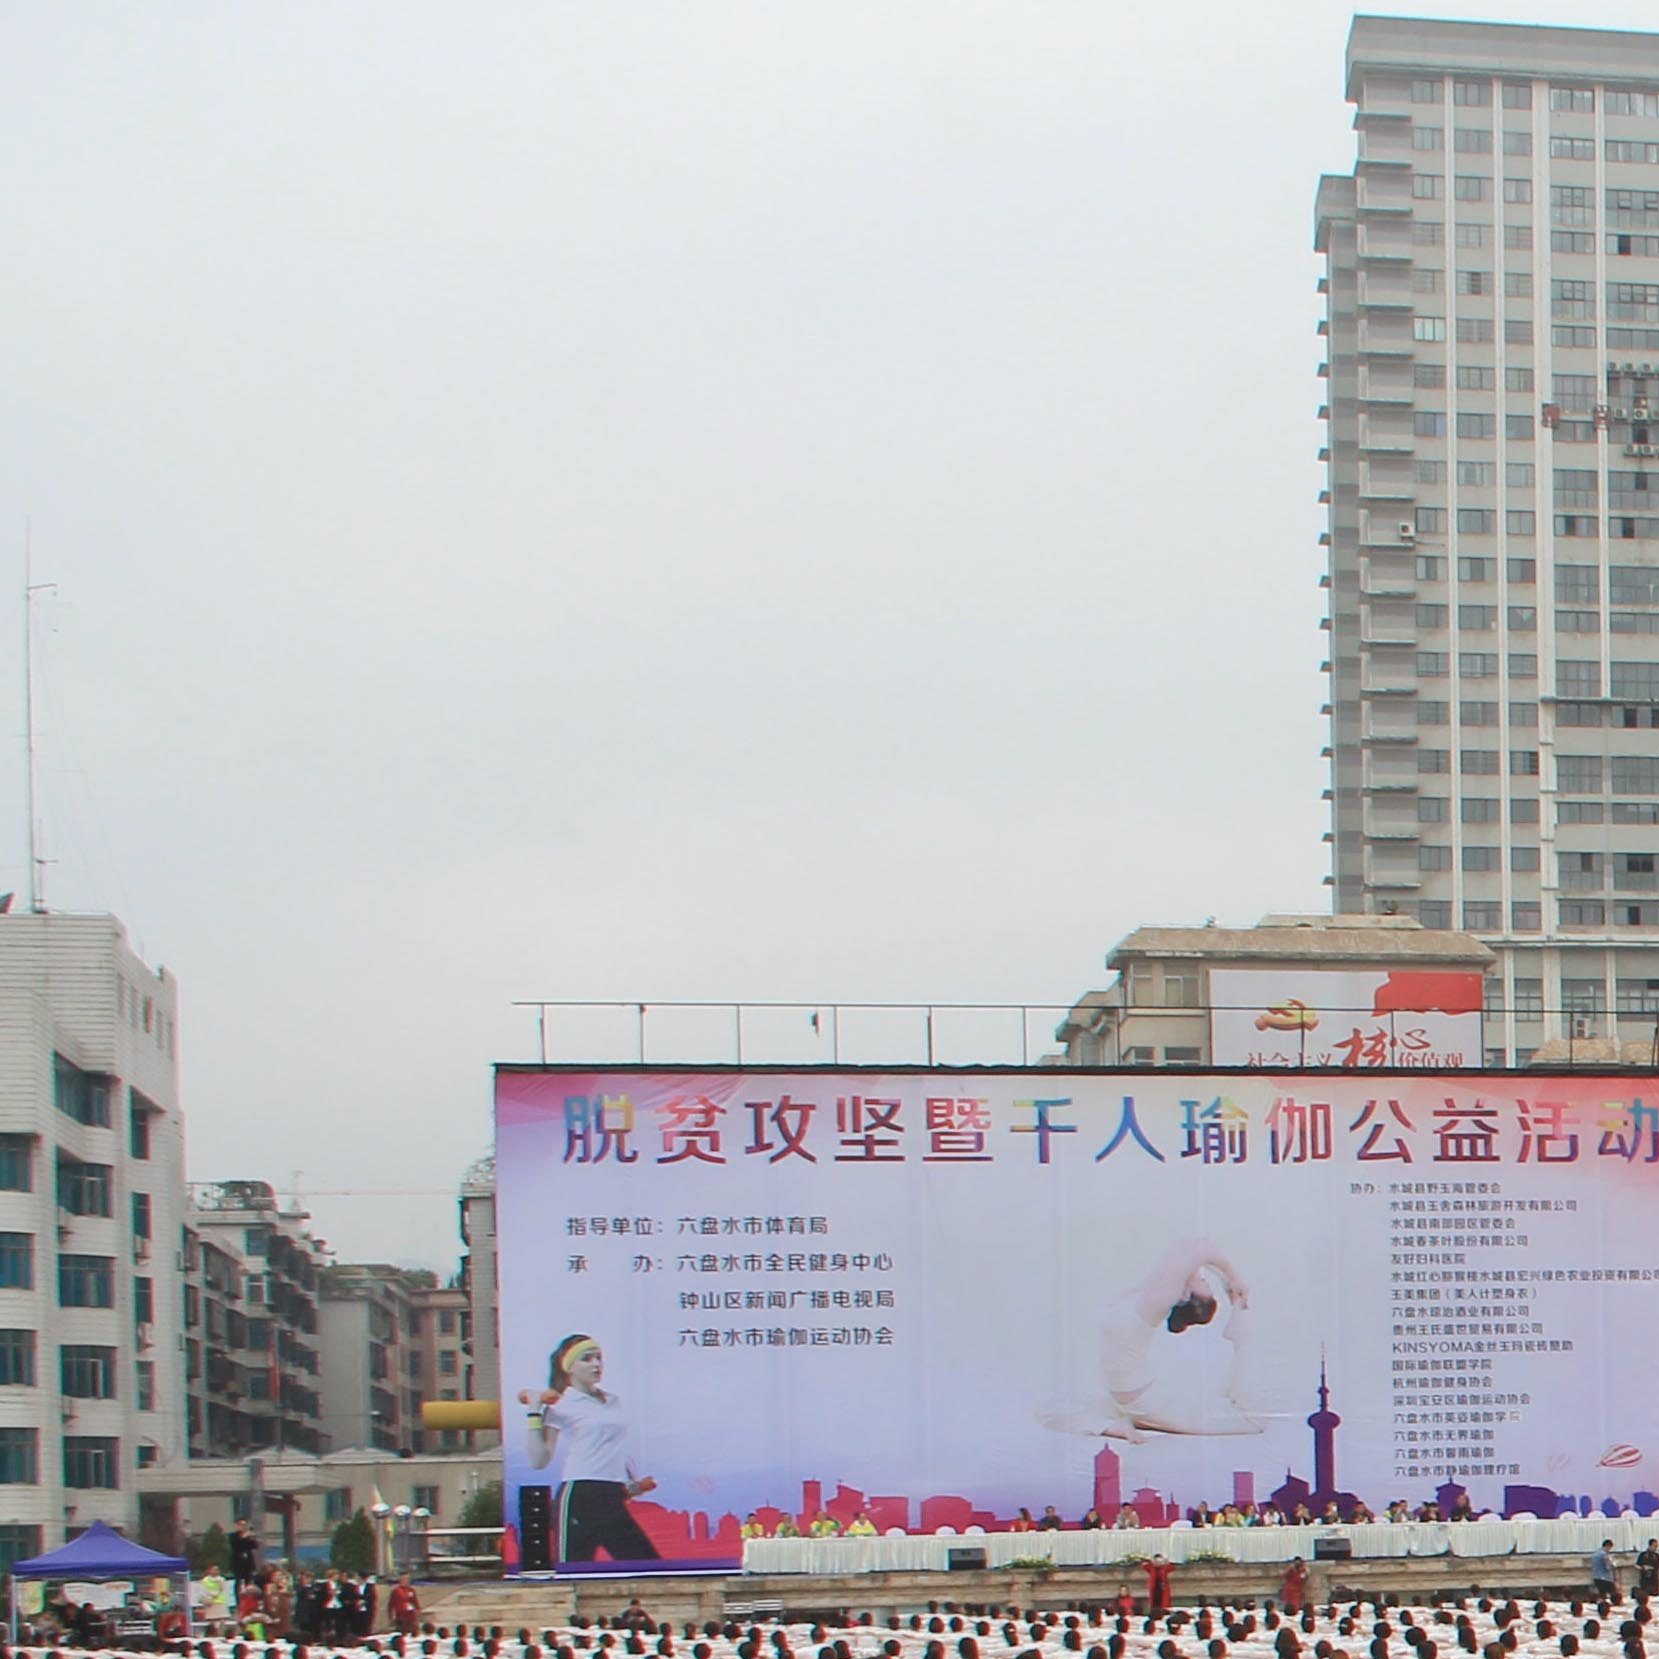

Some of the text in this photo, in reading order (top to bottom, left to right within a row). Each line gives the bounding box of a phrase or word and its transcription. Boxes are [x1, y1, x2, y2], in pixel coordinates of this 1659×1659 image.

[679, 1290, 896, 1310] 钟山区新闻广播电视局
[679, 1326, 894, 1347] 六盘水市瑜伽运动协会
